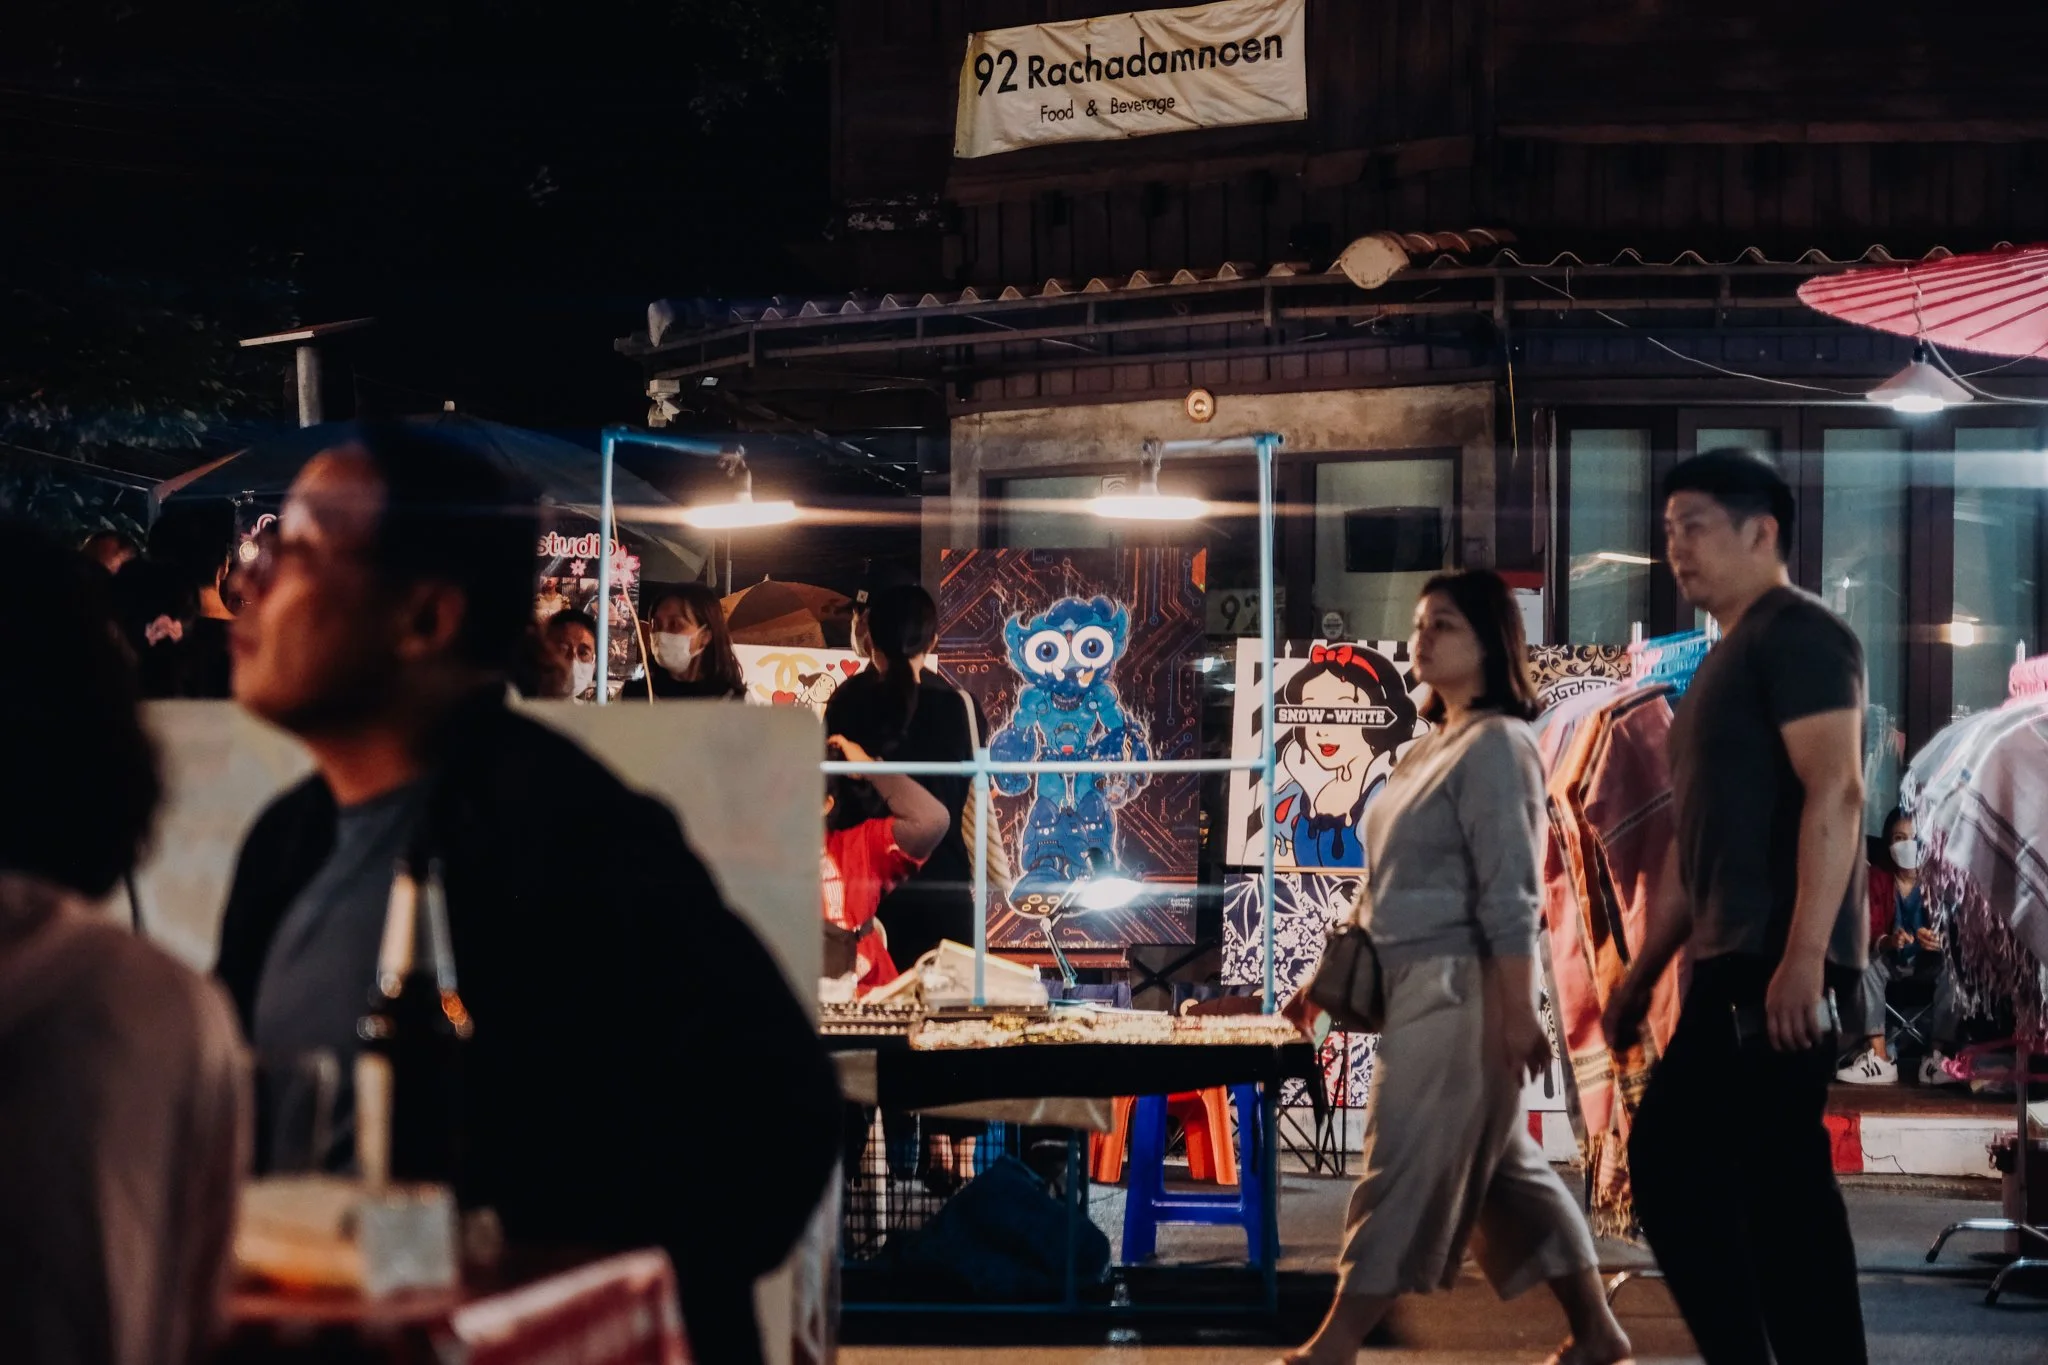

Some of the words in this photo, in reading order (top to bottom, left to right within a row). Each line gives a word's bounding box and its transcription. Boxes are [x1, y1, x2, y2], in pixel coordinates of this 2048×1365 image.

[974, 50, 1018, 96] 92
[1028, 35, 1283, 89] Rachadamnoen
[1041, 100, 1074, 123] Food
[1086, 102, 1099, 117] &
[1110, 95, 1176, 116] Beverage
